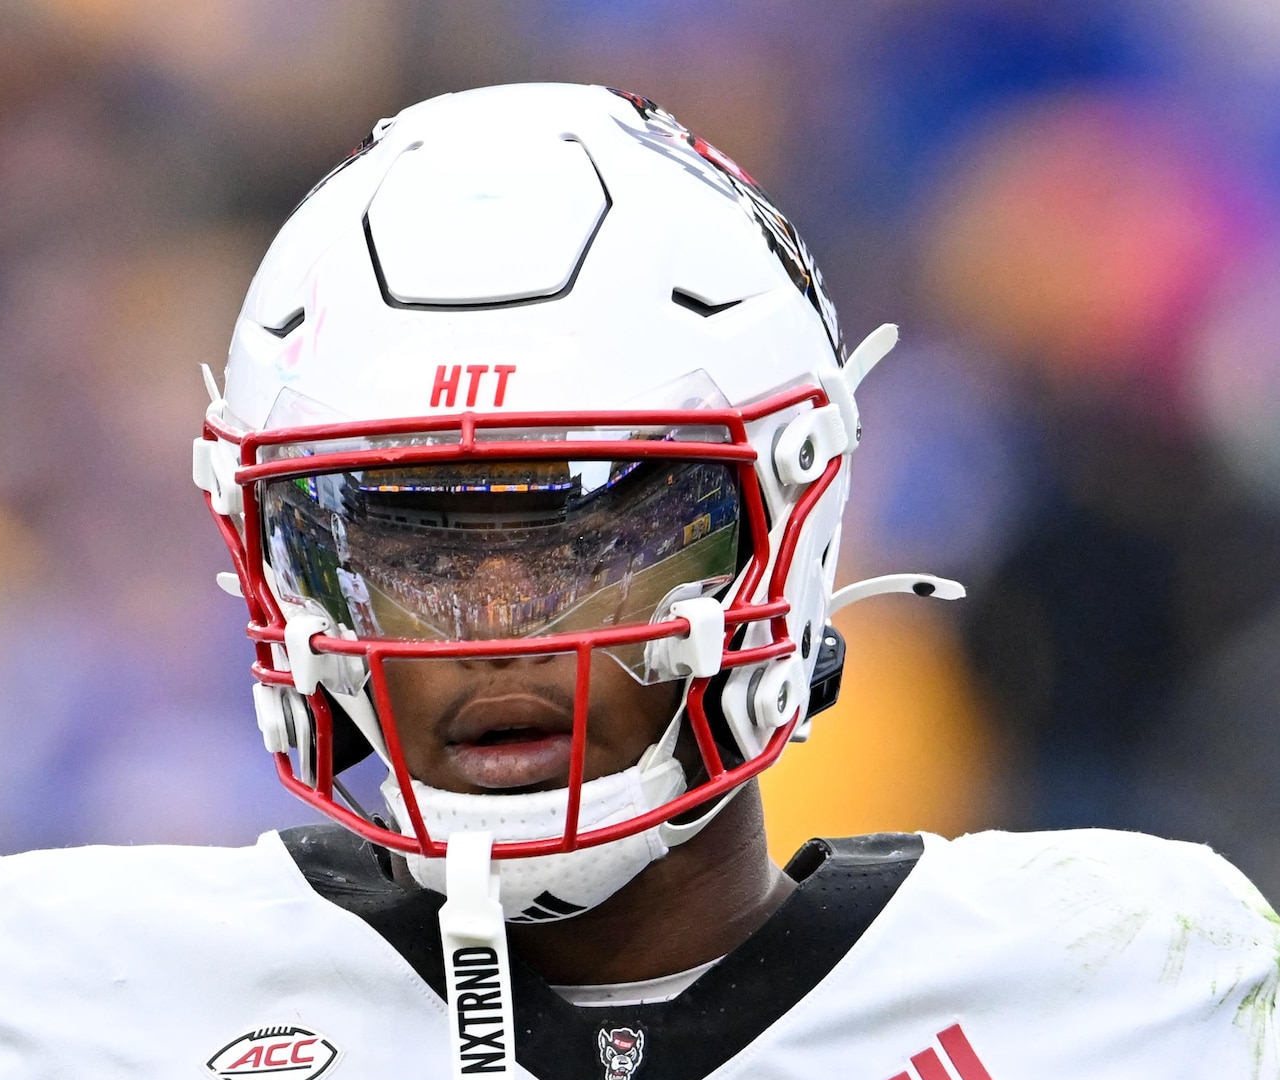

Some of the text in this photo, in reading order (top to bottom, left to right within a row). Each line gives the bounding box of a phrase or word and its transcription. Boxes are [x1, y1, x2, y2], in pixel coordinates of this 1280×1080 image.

[429, 364, 517, 407] HTT
[451, 946, 507, 1075] NXTRND
[226, 1038, 320, 1070] ACC
